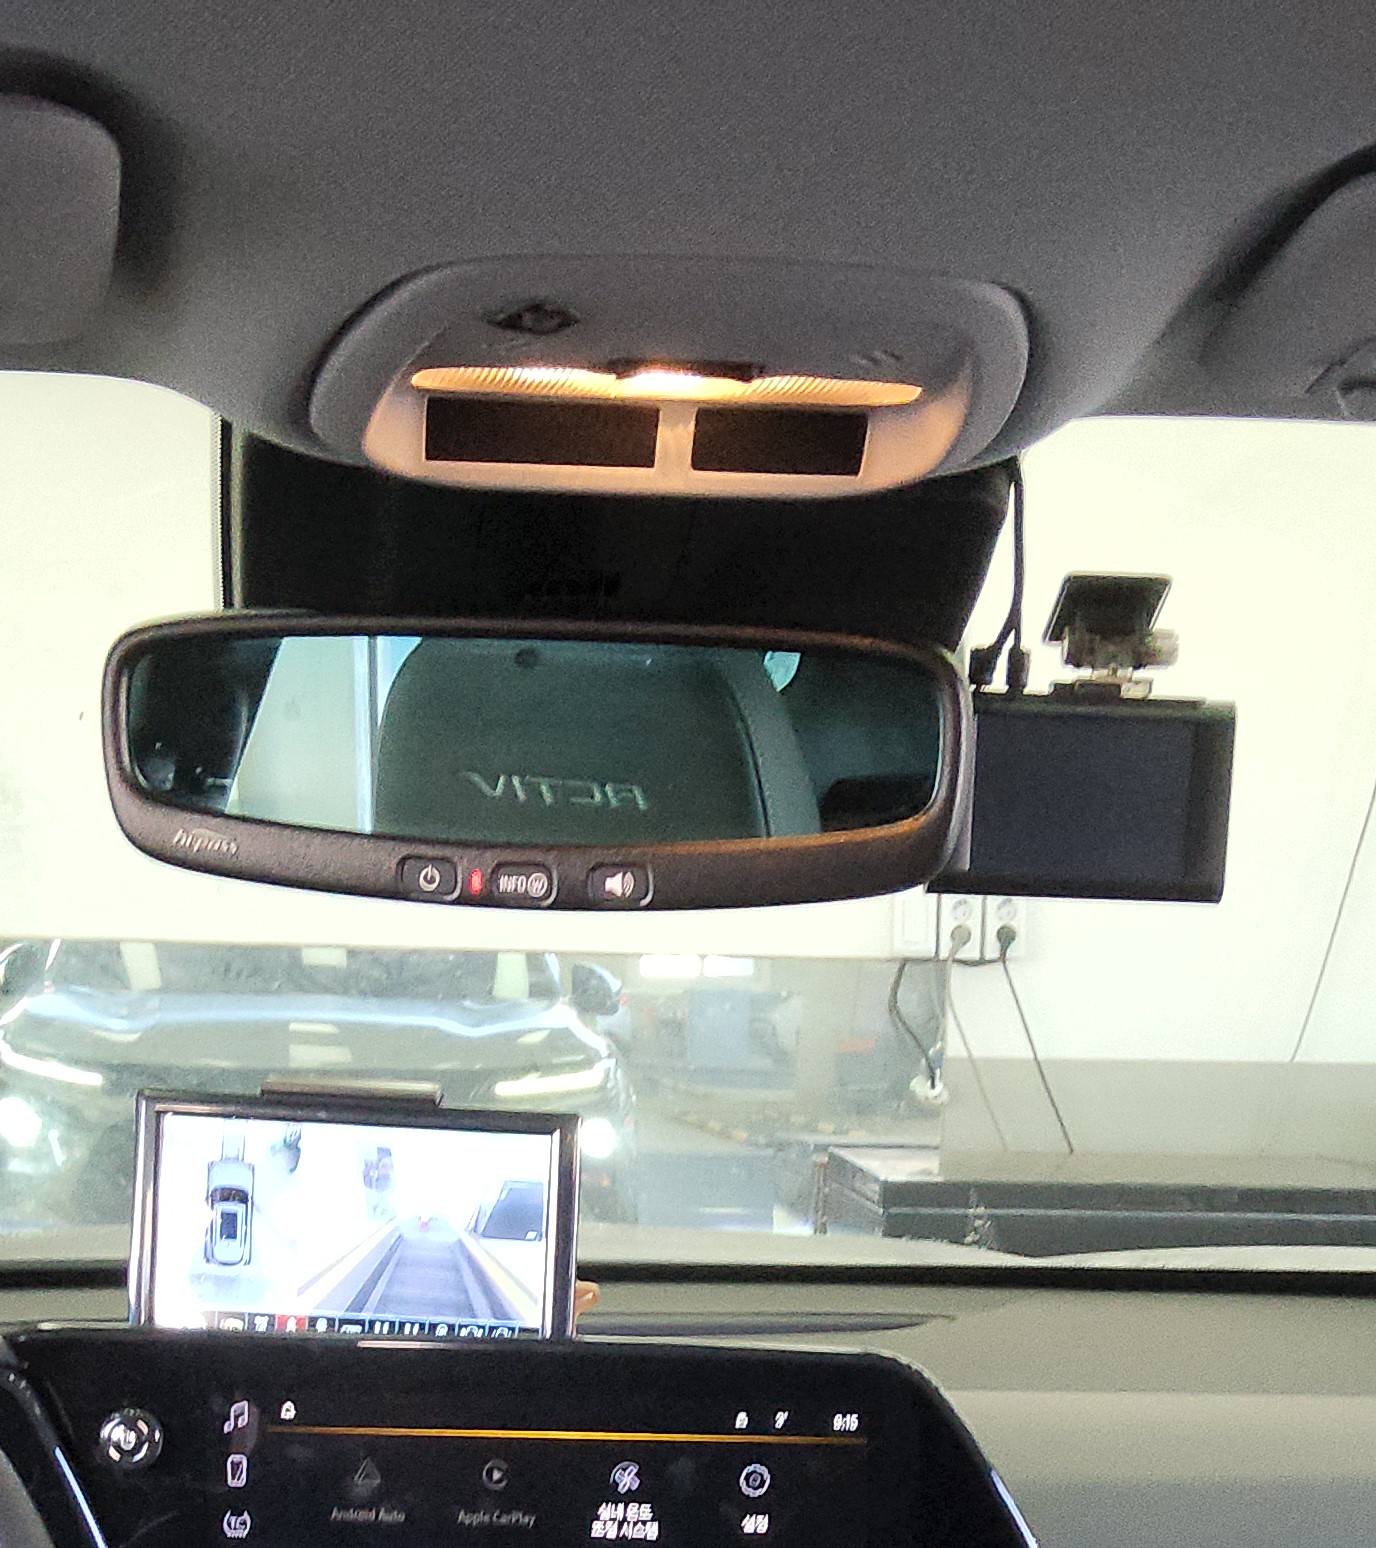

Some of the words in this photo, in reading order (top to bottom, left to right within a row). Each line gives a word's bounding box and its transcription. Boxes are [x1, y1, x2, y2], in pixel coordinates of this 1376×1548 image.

[330, 1507, 376, 1522] Android
[378, 1508, 406, 1523] Auto
[457, 1509, 490, 1527] Apple
